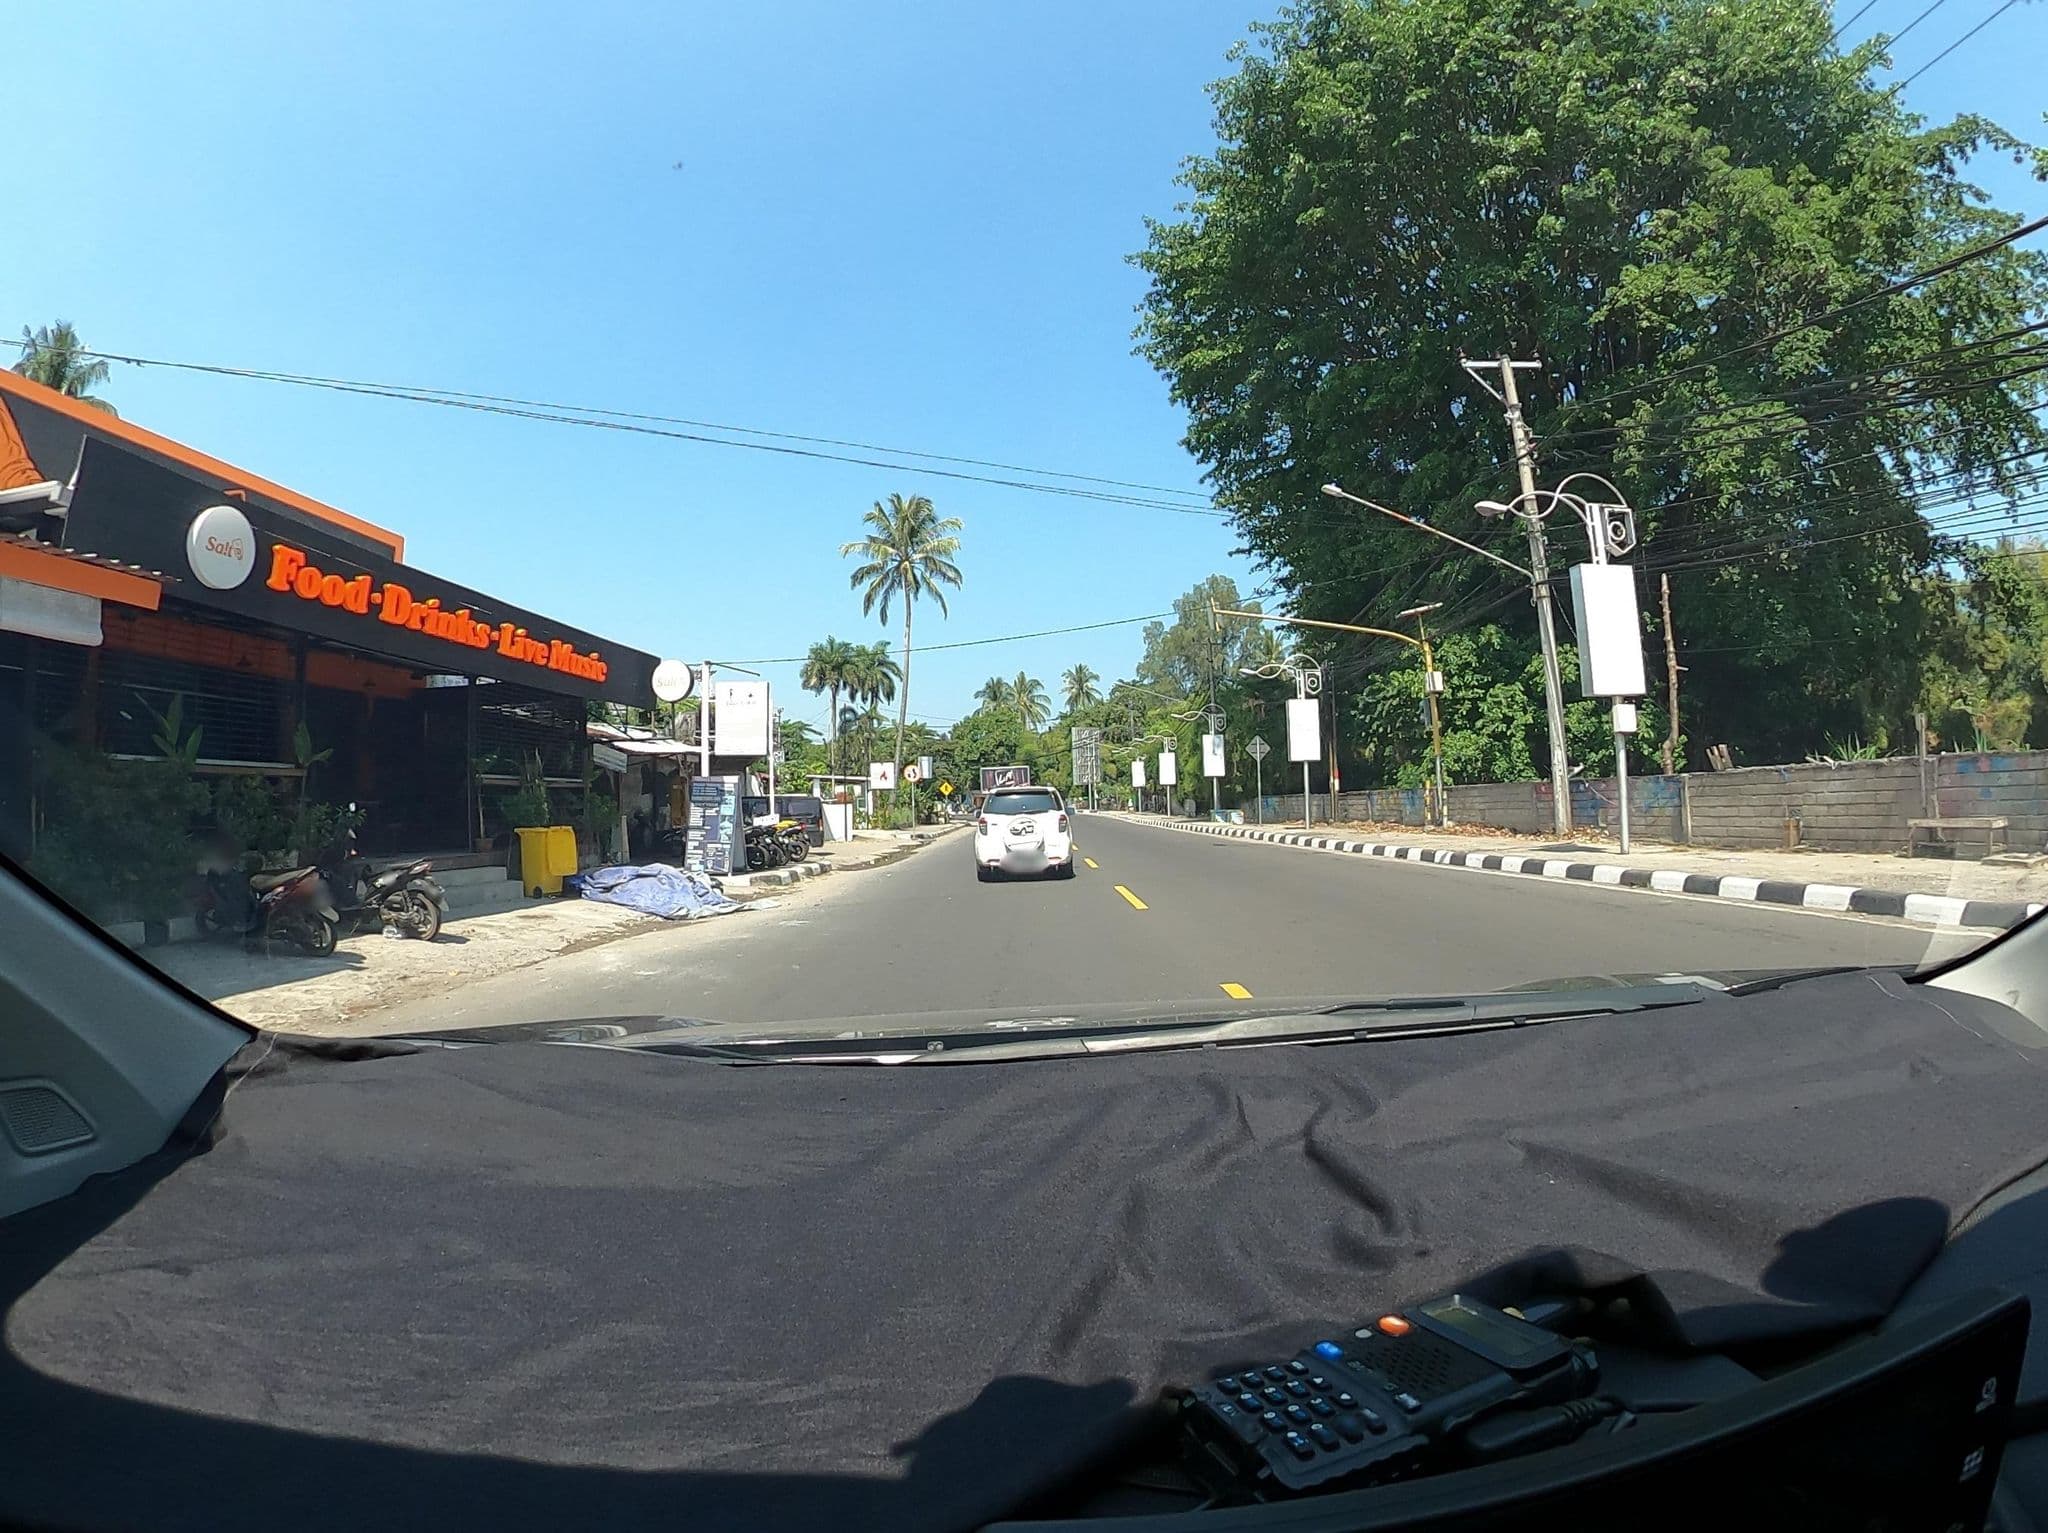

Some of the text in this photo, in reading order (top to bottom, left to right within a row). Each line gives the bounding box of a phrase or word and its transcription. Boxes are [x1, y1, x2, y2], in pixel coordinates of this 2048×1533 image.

[266, 544, 608, 683] Food Drinks Live Music
